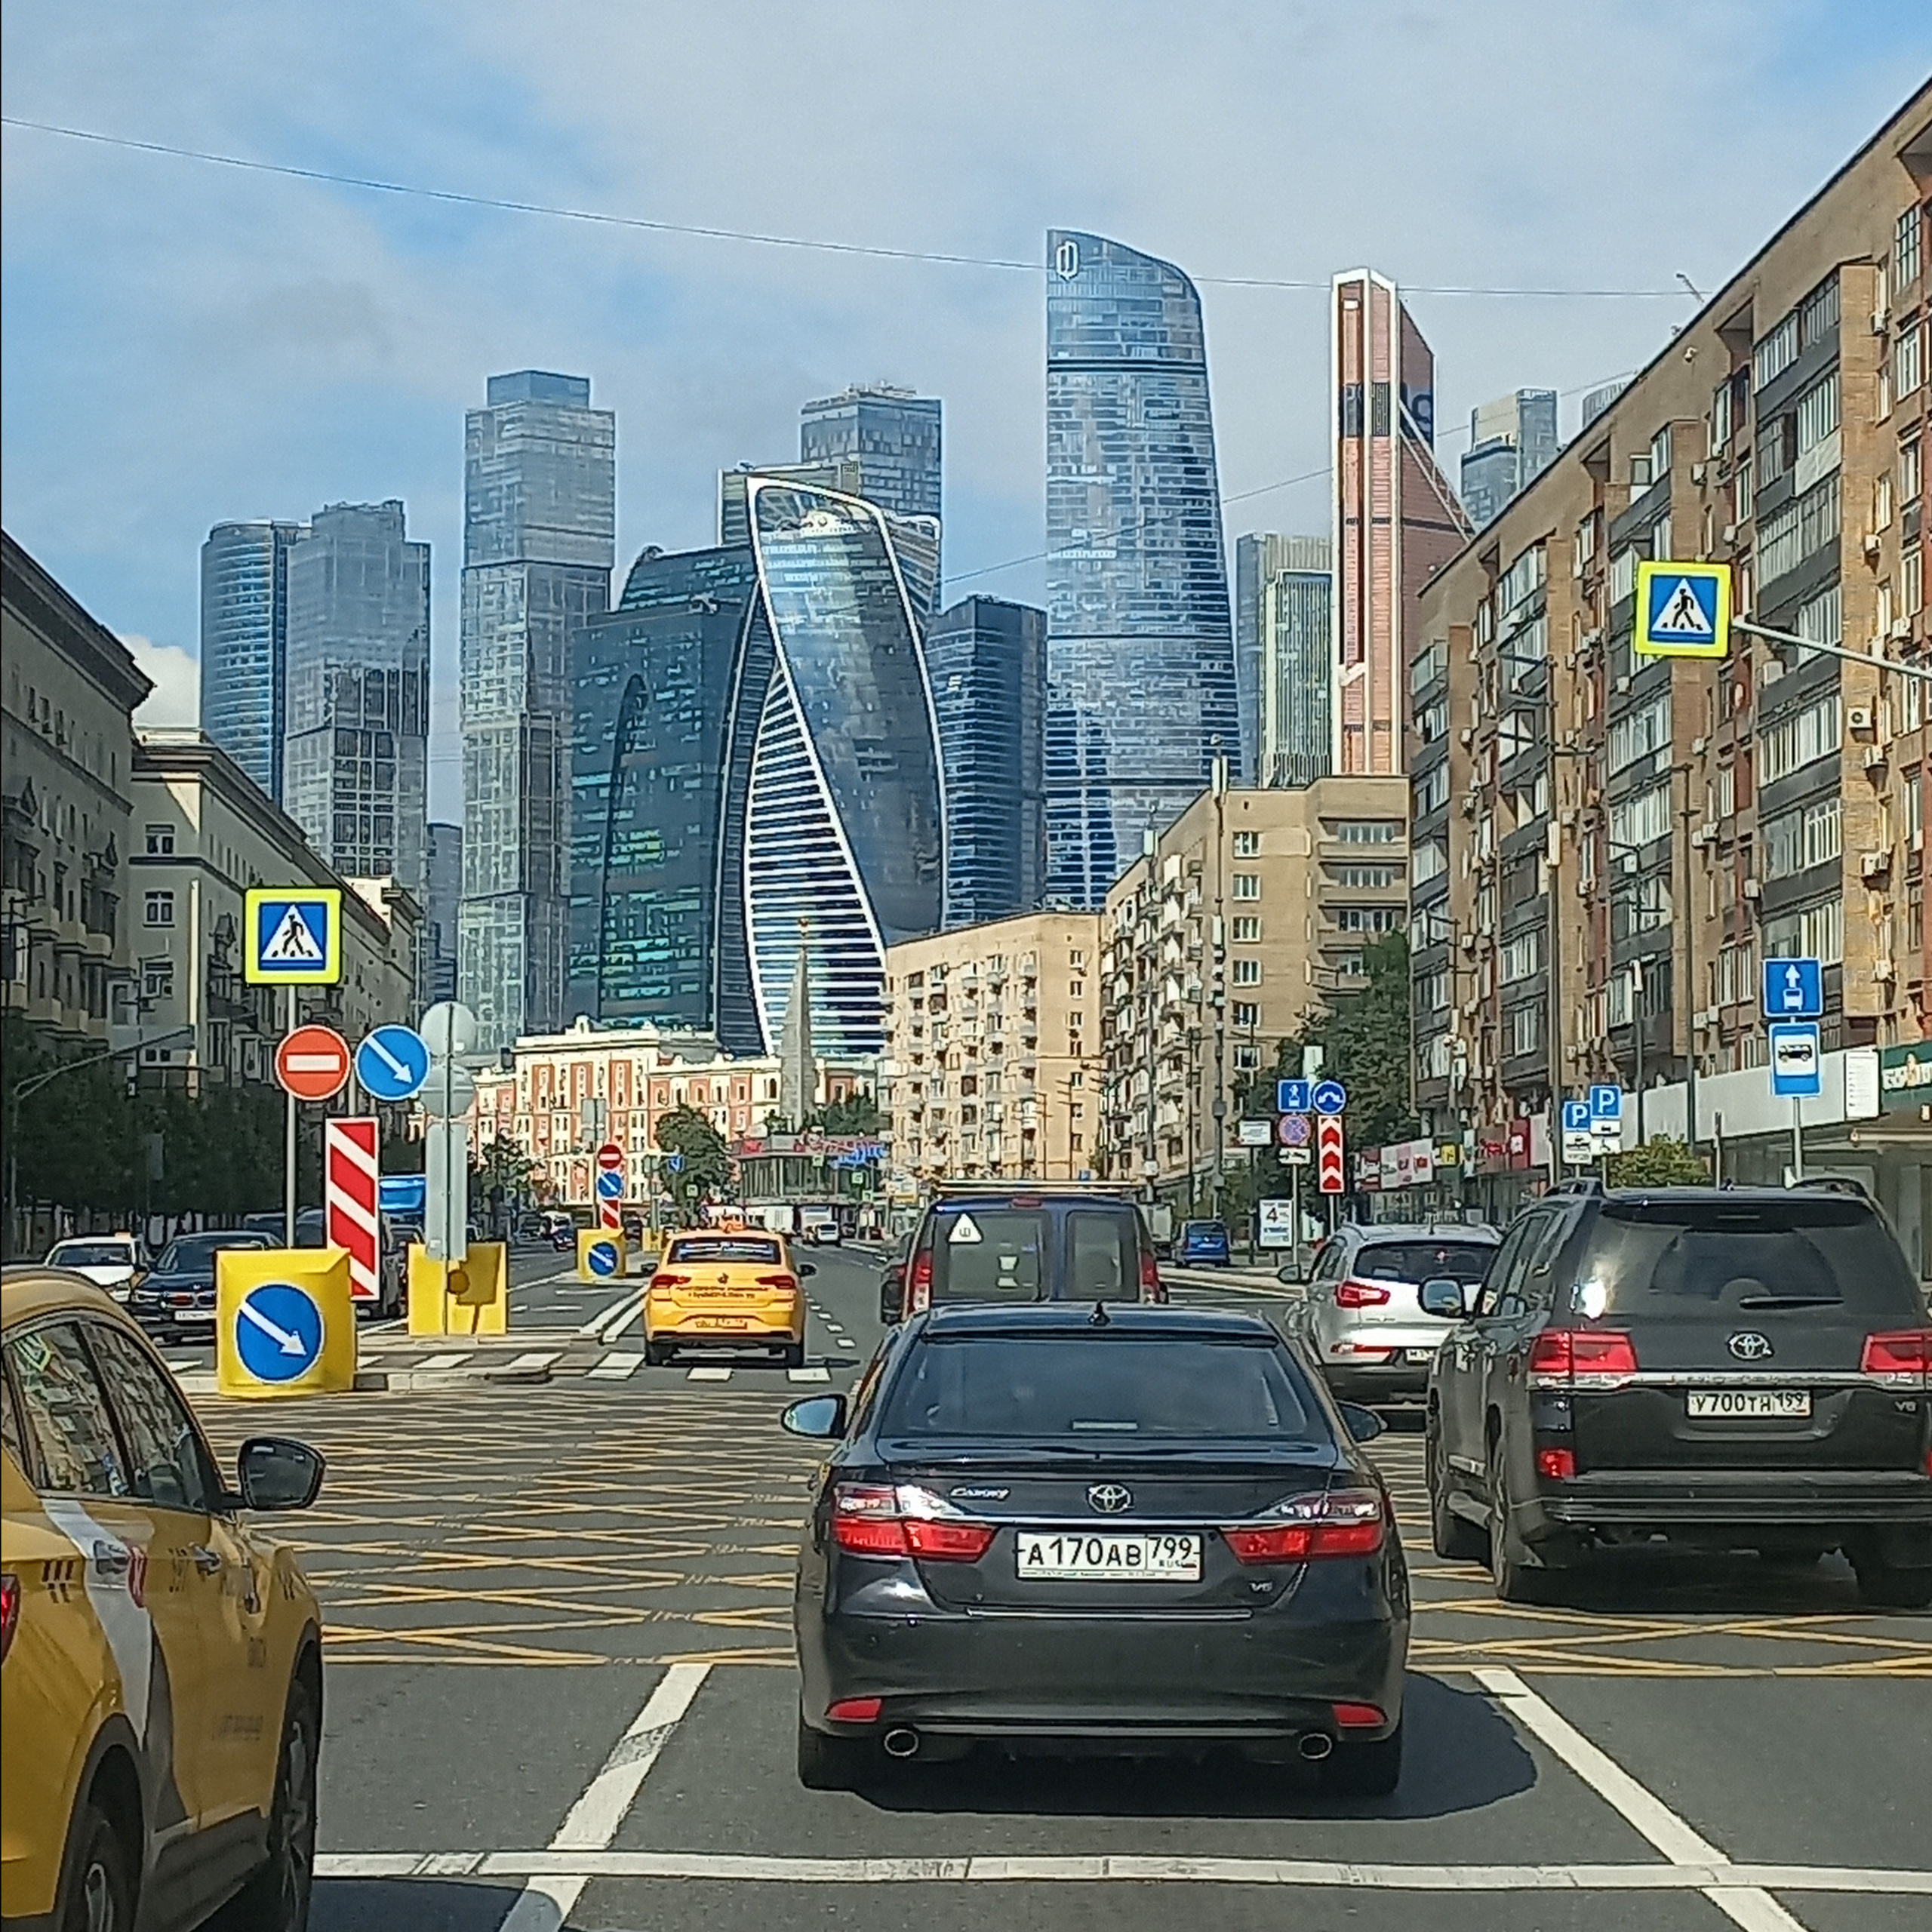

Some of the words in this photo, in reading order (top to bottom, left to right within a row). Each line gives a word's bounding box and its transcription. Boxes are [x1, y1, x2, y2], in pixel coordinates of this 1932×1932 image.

[1598, 1089, 1616, 1114] P
[1571, 1104, 1588, 1127] P
[1266, 1208, 1278, 1223] 4
[1027, 1537, 1141, 1567] А170АВ
[1148, 1537, 1192, 1559] 799
